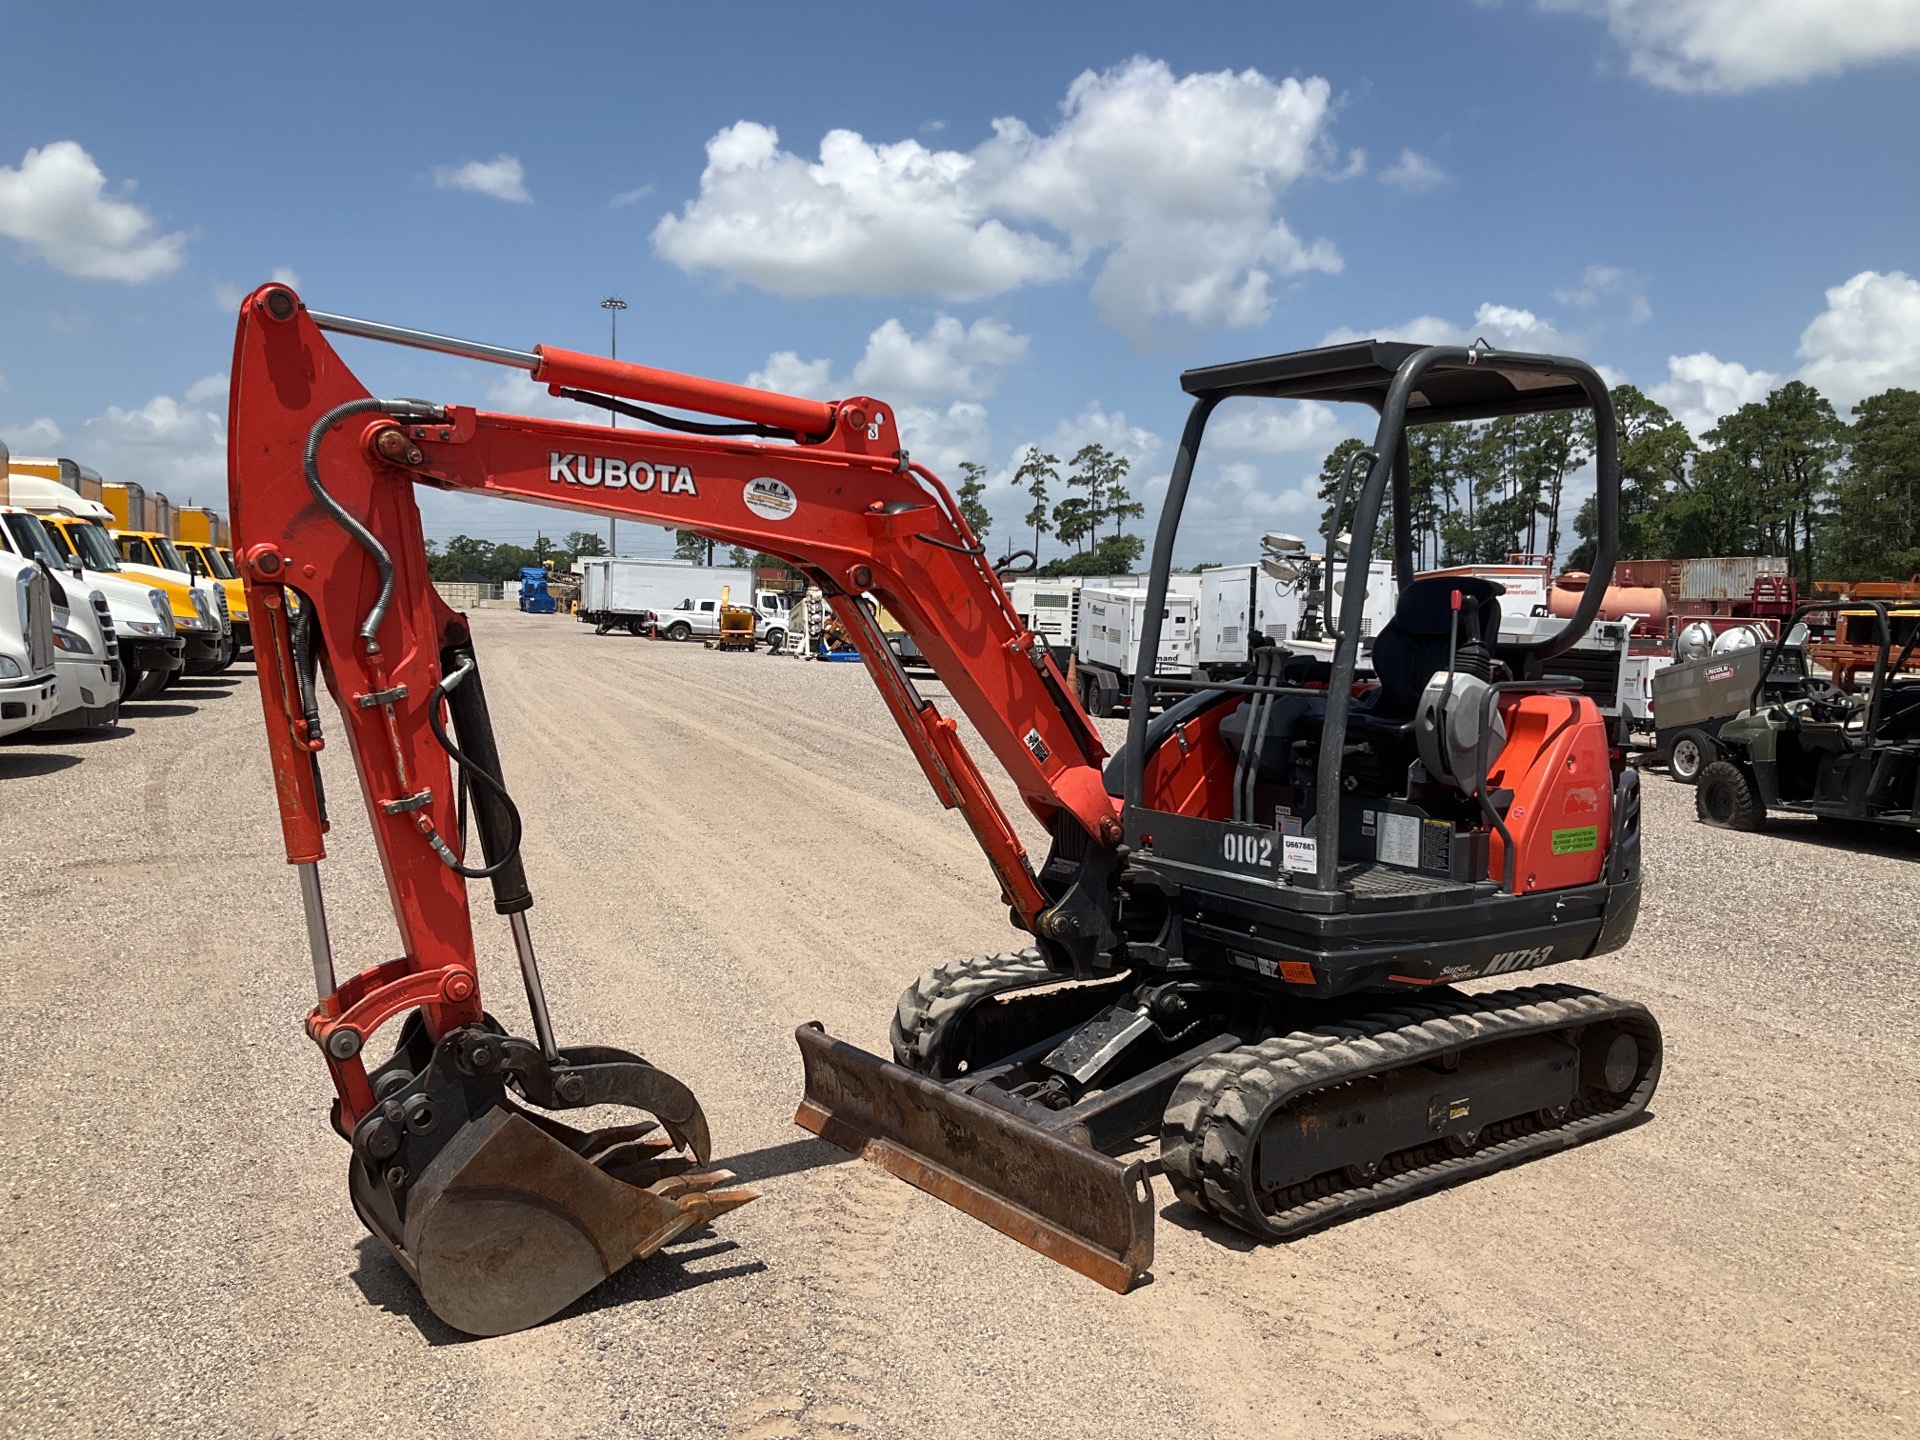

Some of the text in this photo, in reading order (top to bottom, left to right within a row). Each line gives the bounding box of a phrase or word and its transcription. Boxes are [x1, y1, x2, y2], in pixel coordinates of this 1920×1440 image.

[549, 451, 698, 496] KUBOTA
[1156, 653, 1178, 662] mand
[1704, 665, 1730, 677] LINCOLN
[1223, 833, 1273, 868] 0102
[1285, 840, 1316, 851] U667883
[1481, 945, 1554, 976] KX71-3
[1440, 964, 1472, 976] Super
[1452, 969, 1480, 981] Series
